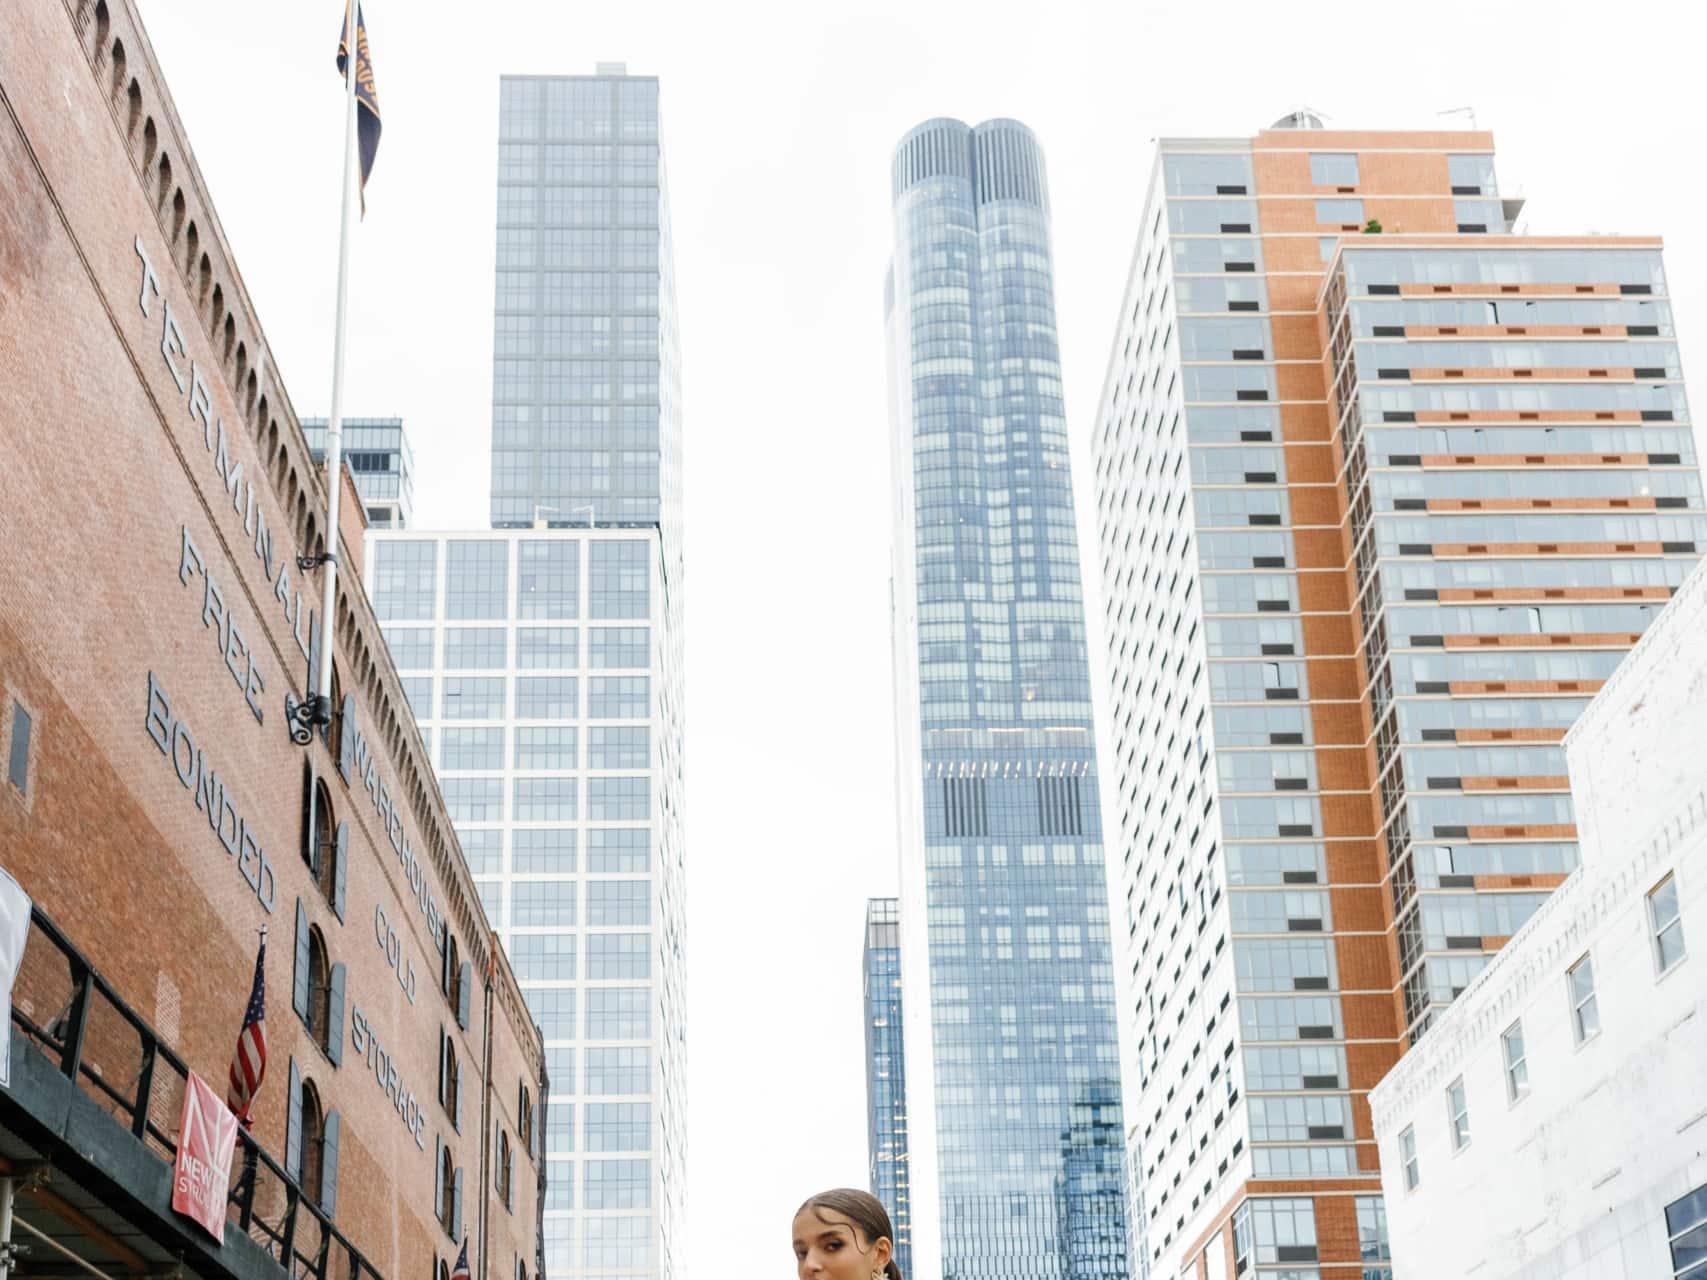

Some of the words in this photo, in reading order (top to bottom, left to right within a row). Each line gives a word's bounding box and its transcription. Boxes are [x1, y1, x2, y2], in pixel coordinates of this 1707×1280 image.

[135, 234, 310, 662] TERMINAL
[352, 730, 445, 958] WAREHOUSE
[179, 524, 265, 726] FREE
[145, 669, 276, 914] BONDED
[375, 903, 415, 1005] COLD
[352, 1004, 425, 1151] STORAGE
[181, 1151, 213, 1186] NEW
